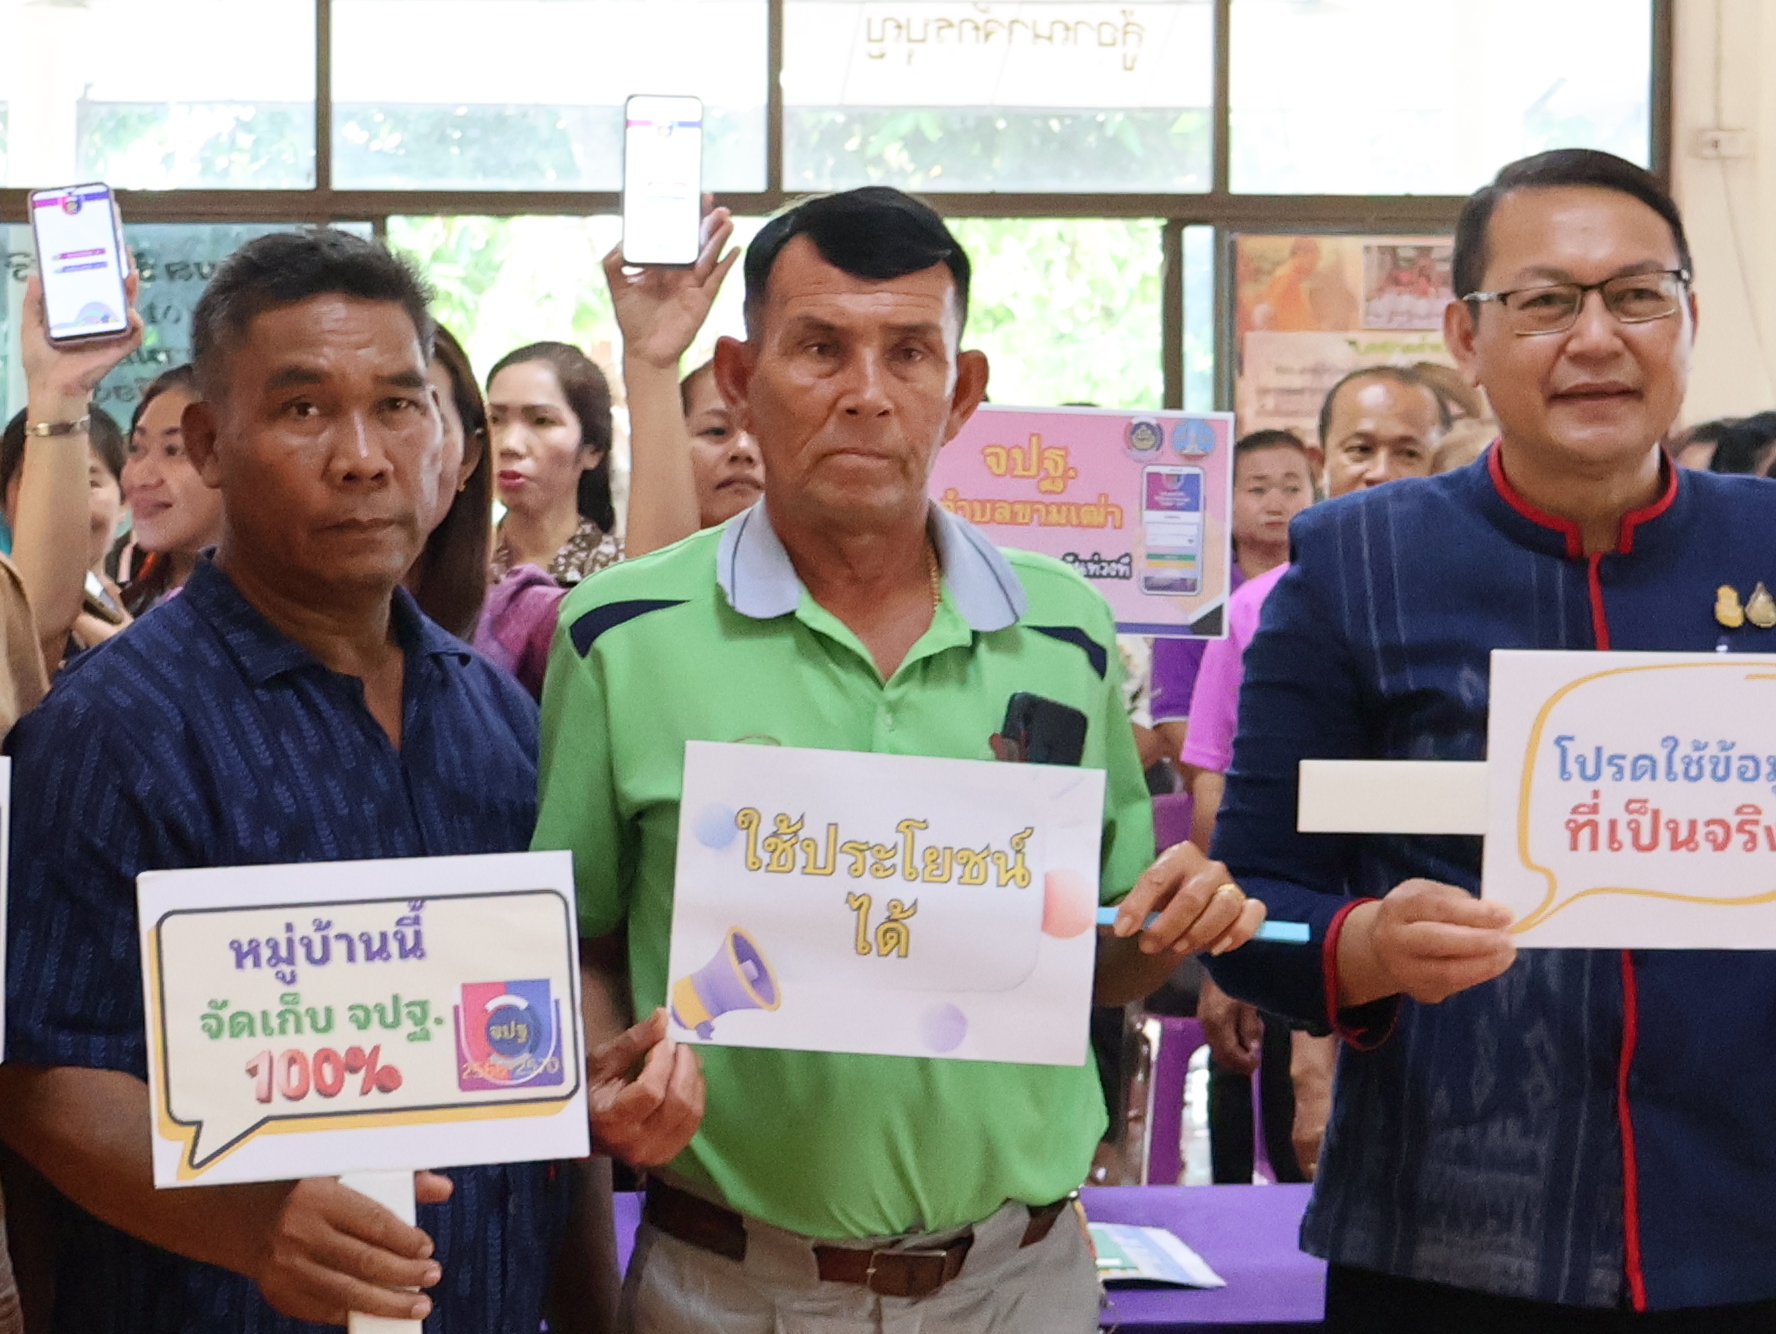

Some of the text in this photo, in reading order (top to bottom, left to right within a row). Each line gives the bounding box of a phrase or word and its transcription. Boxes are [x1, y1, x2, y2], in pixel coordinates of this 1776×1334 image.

[982, 432, 1079, 494] จปฐ.
[735, 807, 1035, 889] ใช้ประโยชน์
[229, 900, 426, 985] หมู่บ้านนี้
[846, 892, 919, 959] ได้
[200, 992, 445, 1044] จัดเก็บ จปฐ.
[245, 1044, 403, 1104] 100%
